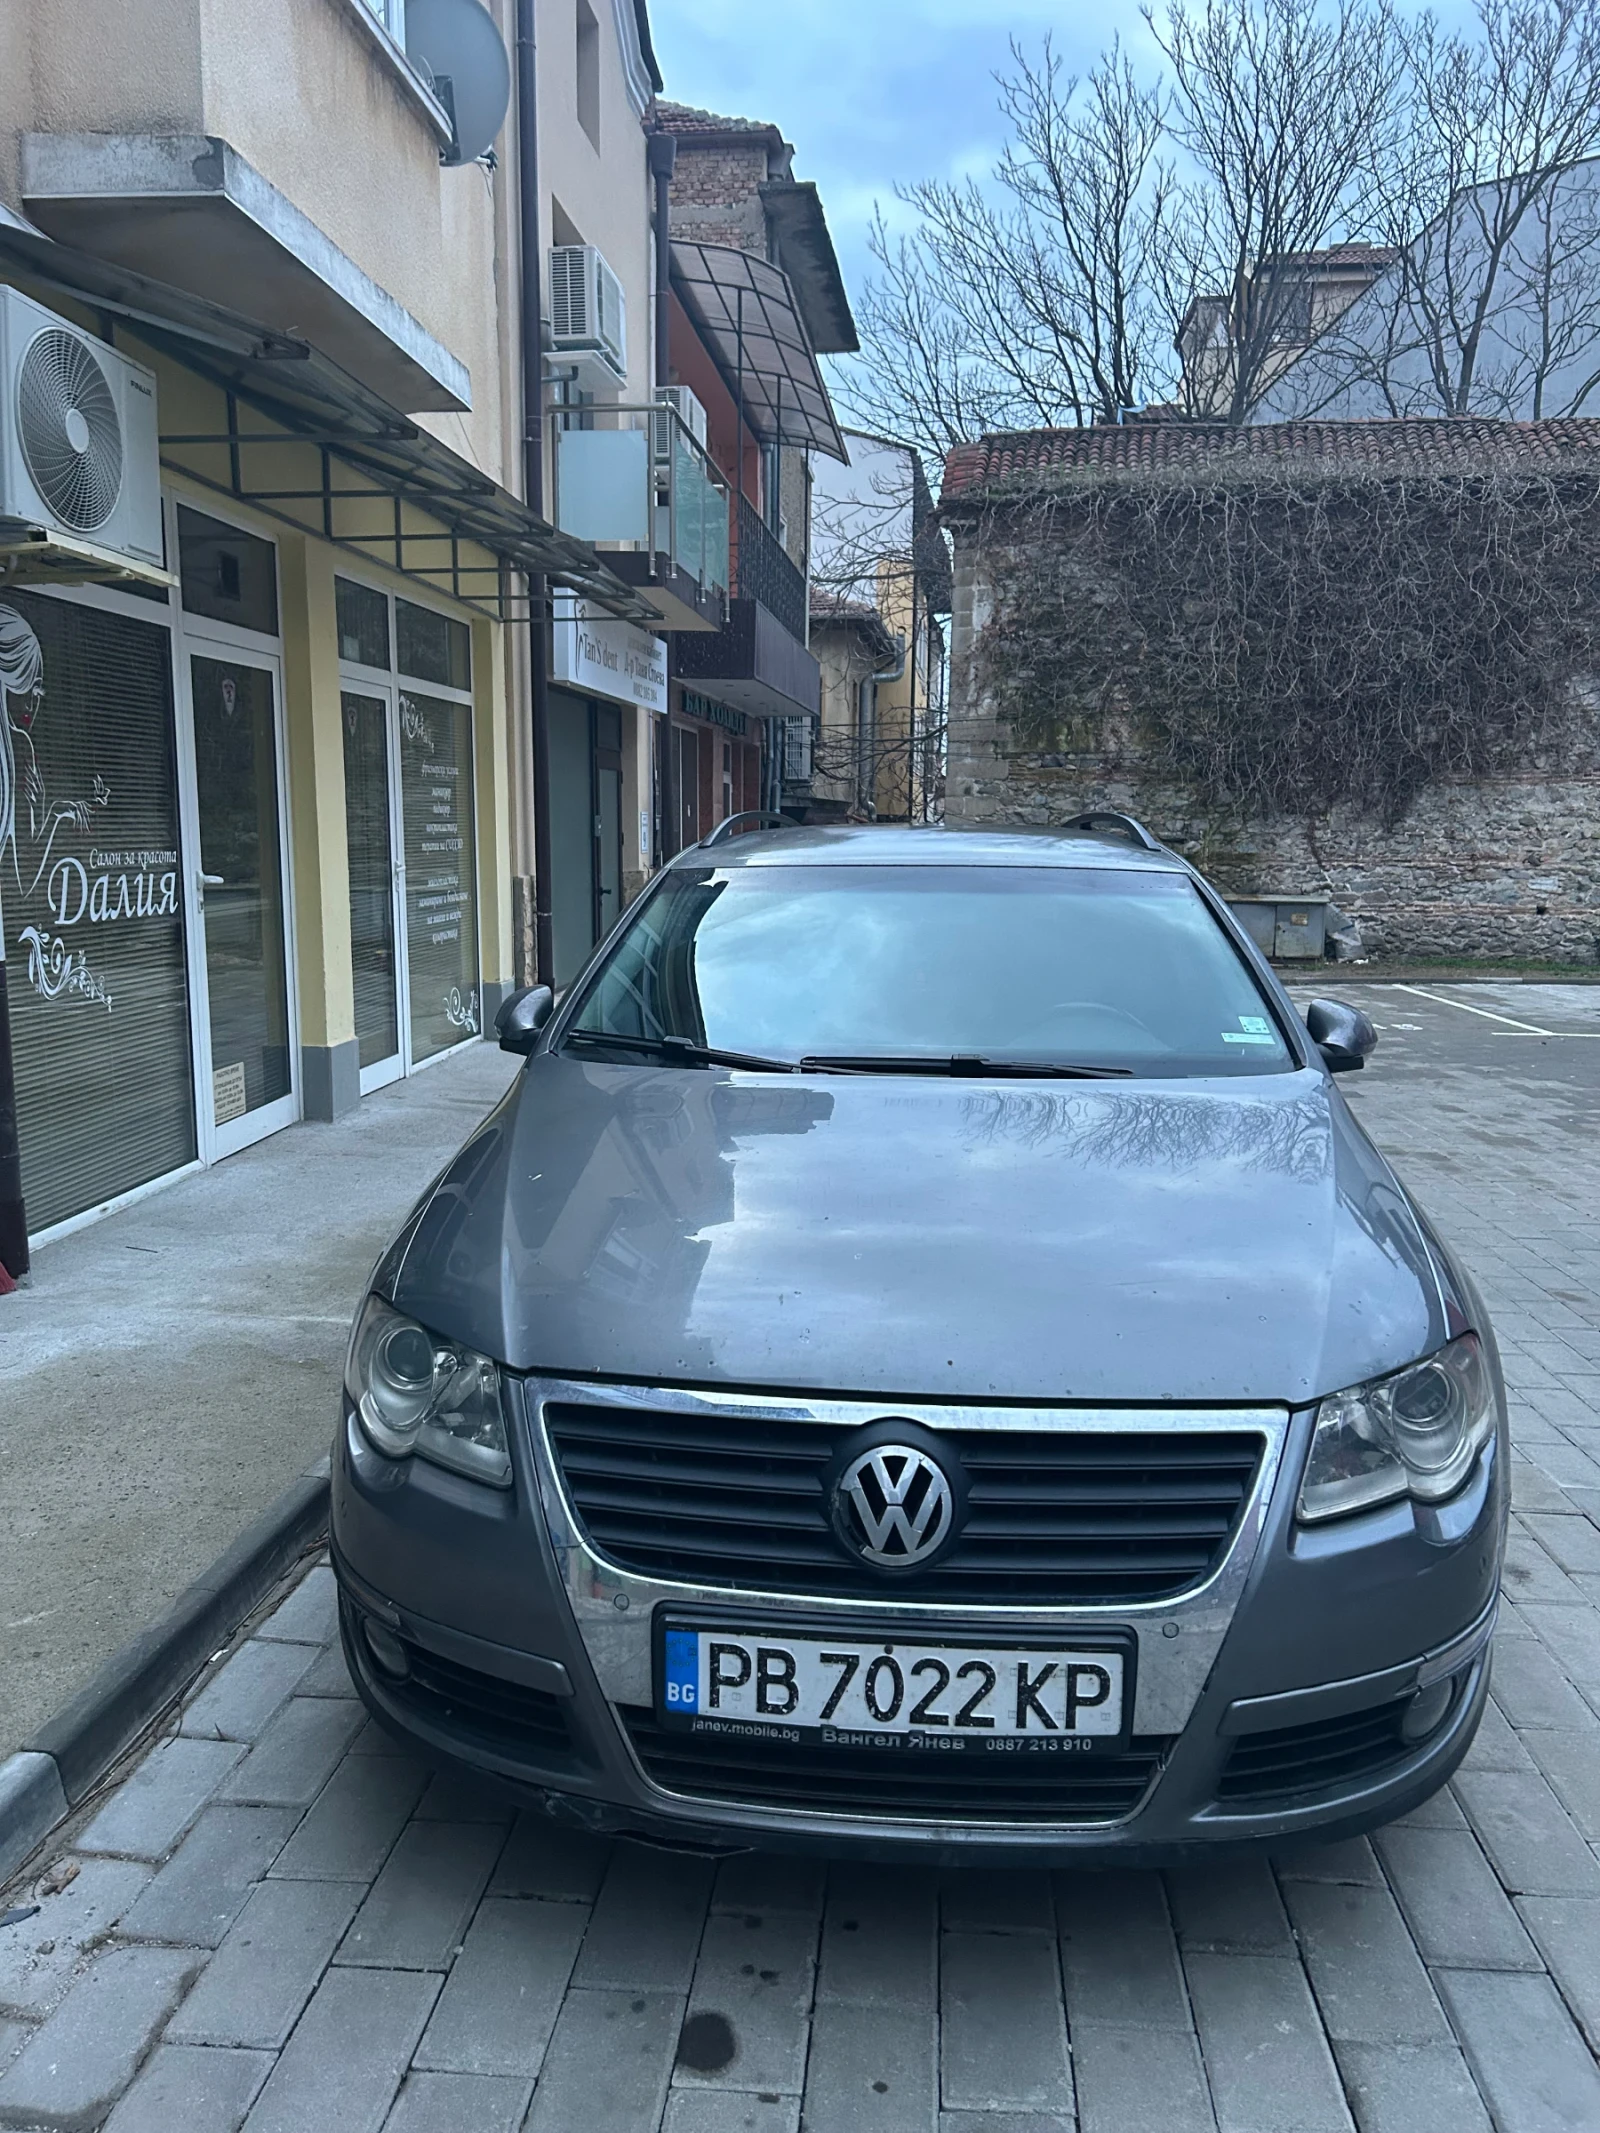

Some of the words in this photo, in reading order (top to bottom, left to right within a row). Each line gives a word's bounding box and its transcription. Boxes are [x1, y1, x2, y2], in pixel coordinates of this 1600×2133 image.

[602, 641, 619, 673] dent
[89, 848, 122, 869] Салон
[123, 851, 136, 866] за
[138, 850, 178, 870] красота
[48, 857, 179, 926] Далия
[667, 1681, 696, 1703] BG
[709, 1642, 800, 1716] PB
[819, 1650, 997, 1728] 7022
[1015, 1662, 1111, 1730] KP
[692, 1718, 801, 1743] janev.mobile.bg
[822, 1726, 900, 1747] Вангел
[908, 1732, 966, 1750] Янев
[986, 1737, 1025, 1751] 0887
[1028, 1737, 1059, 1752] 213
[1062, 1738, 1092, 1752] 910
